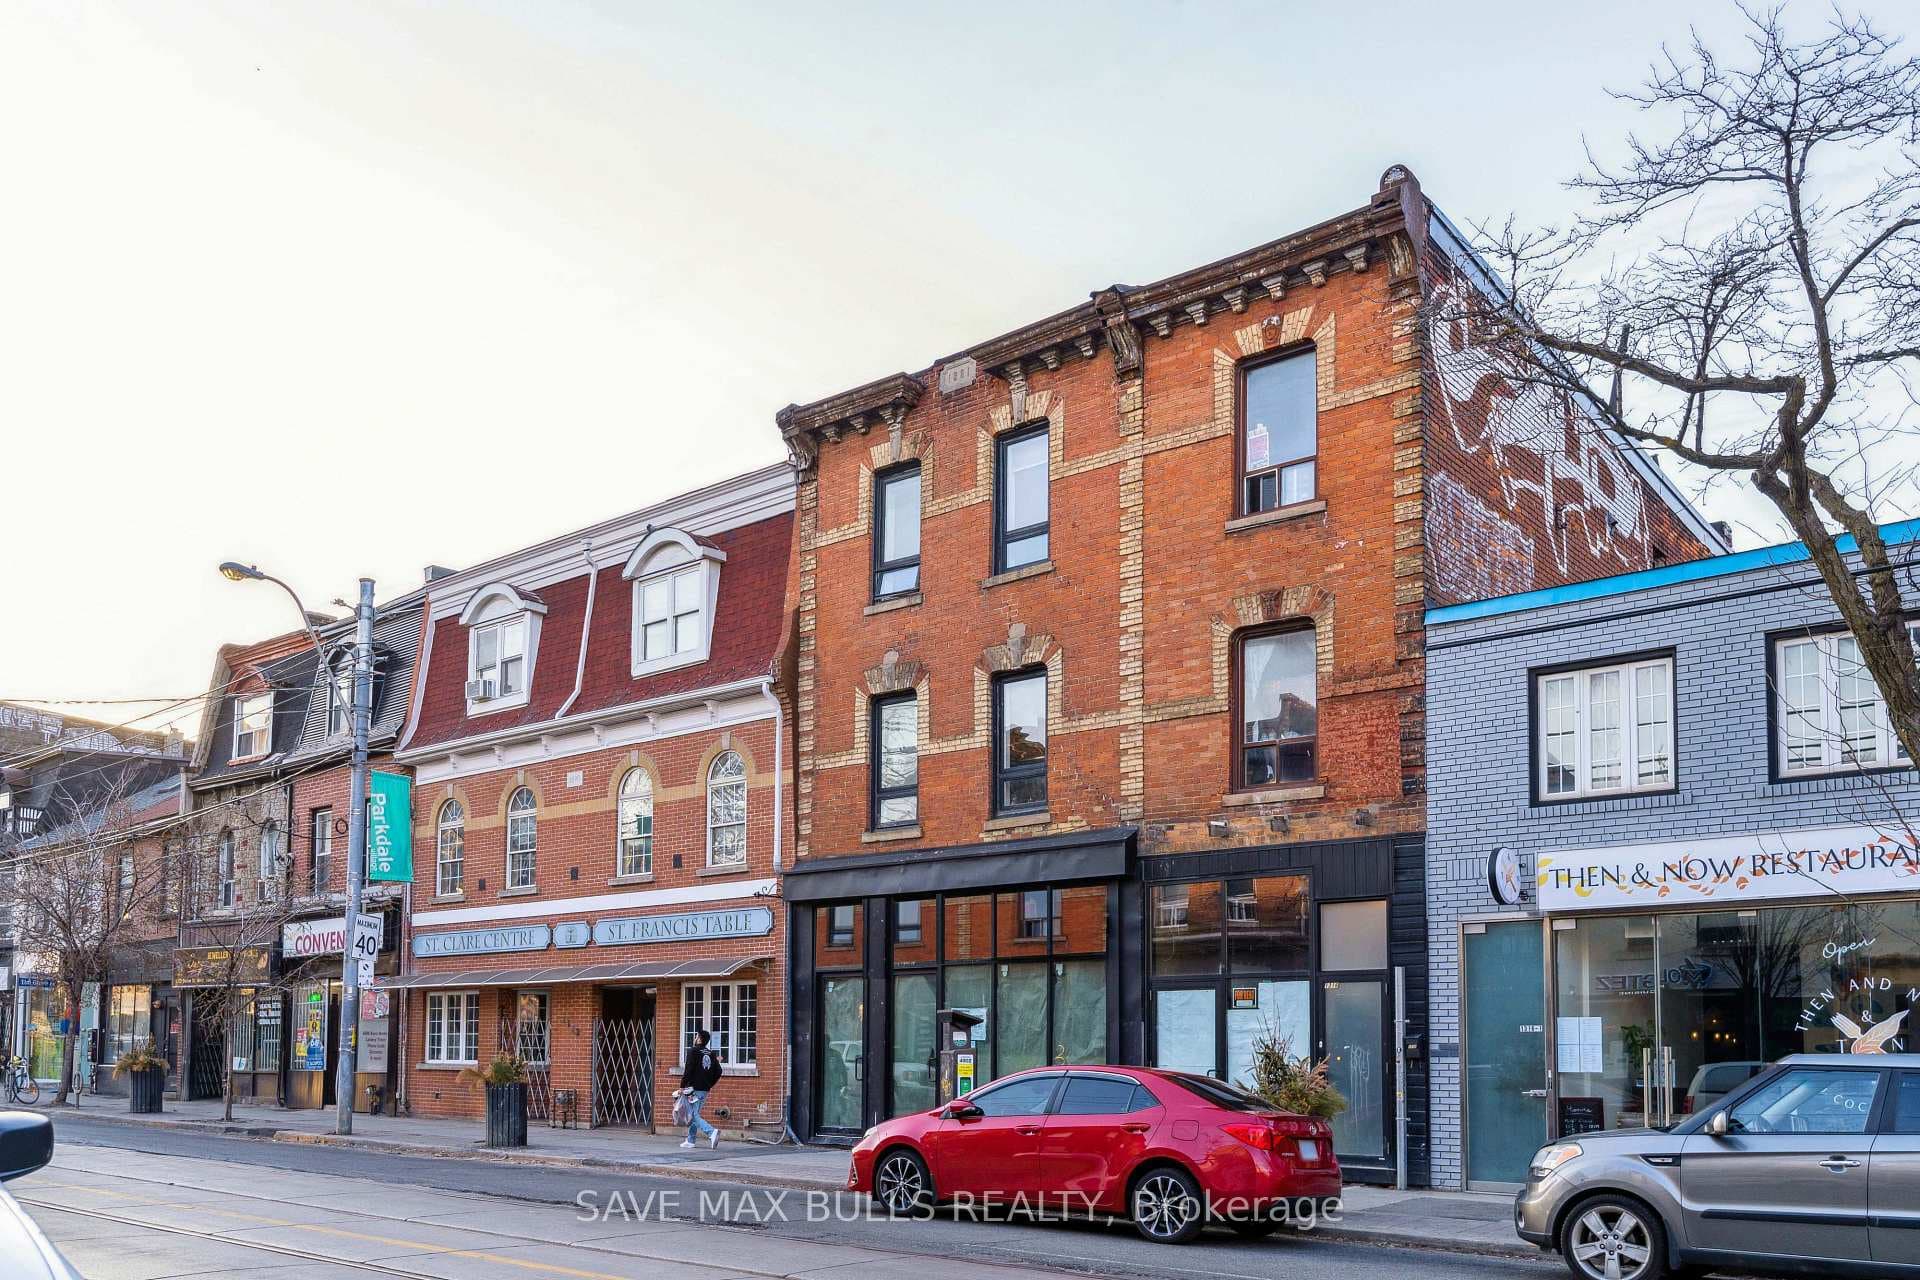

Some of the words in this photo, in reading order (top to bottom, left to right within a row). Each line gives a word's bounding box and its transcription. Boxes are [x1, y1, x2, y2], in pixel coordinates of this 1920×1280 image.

[371, 793, 394, 873] Parkdale
[1548, 864, 1620, 888] THEN
[1631, 862, 1659, 888] &
[1662, 855, 1741, 882] NOW
[1752, 843, 1920, 876] RESTAURA
[425, 937, 439, 952] ST.
[443, 934, 481, 951] CLARE
[484, 929, 535, 948] CENTRE
[608, 924, 627, 941] ST.
[632, 917, 698, 938] FRANCIS
[700, 913, 752, 933] TABLE
[355, 934, 376, 956] 40
[1822, 938, 1876, 965] Open
[1794, 988, 1835, 1031] THEN
[1849, 977, 1891, 991] AND
[1861, 1009, 1876, 1024] &
